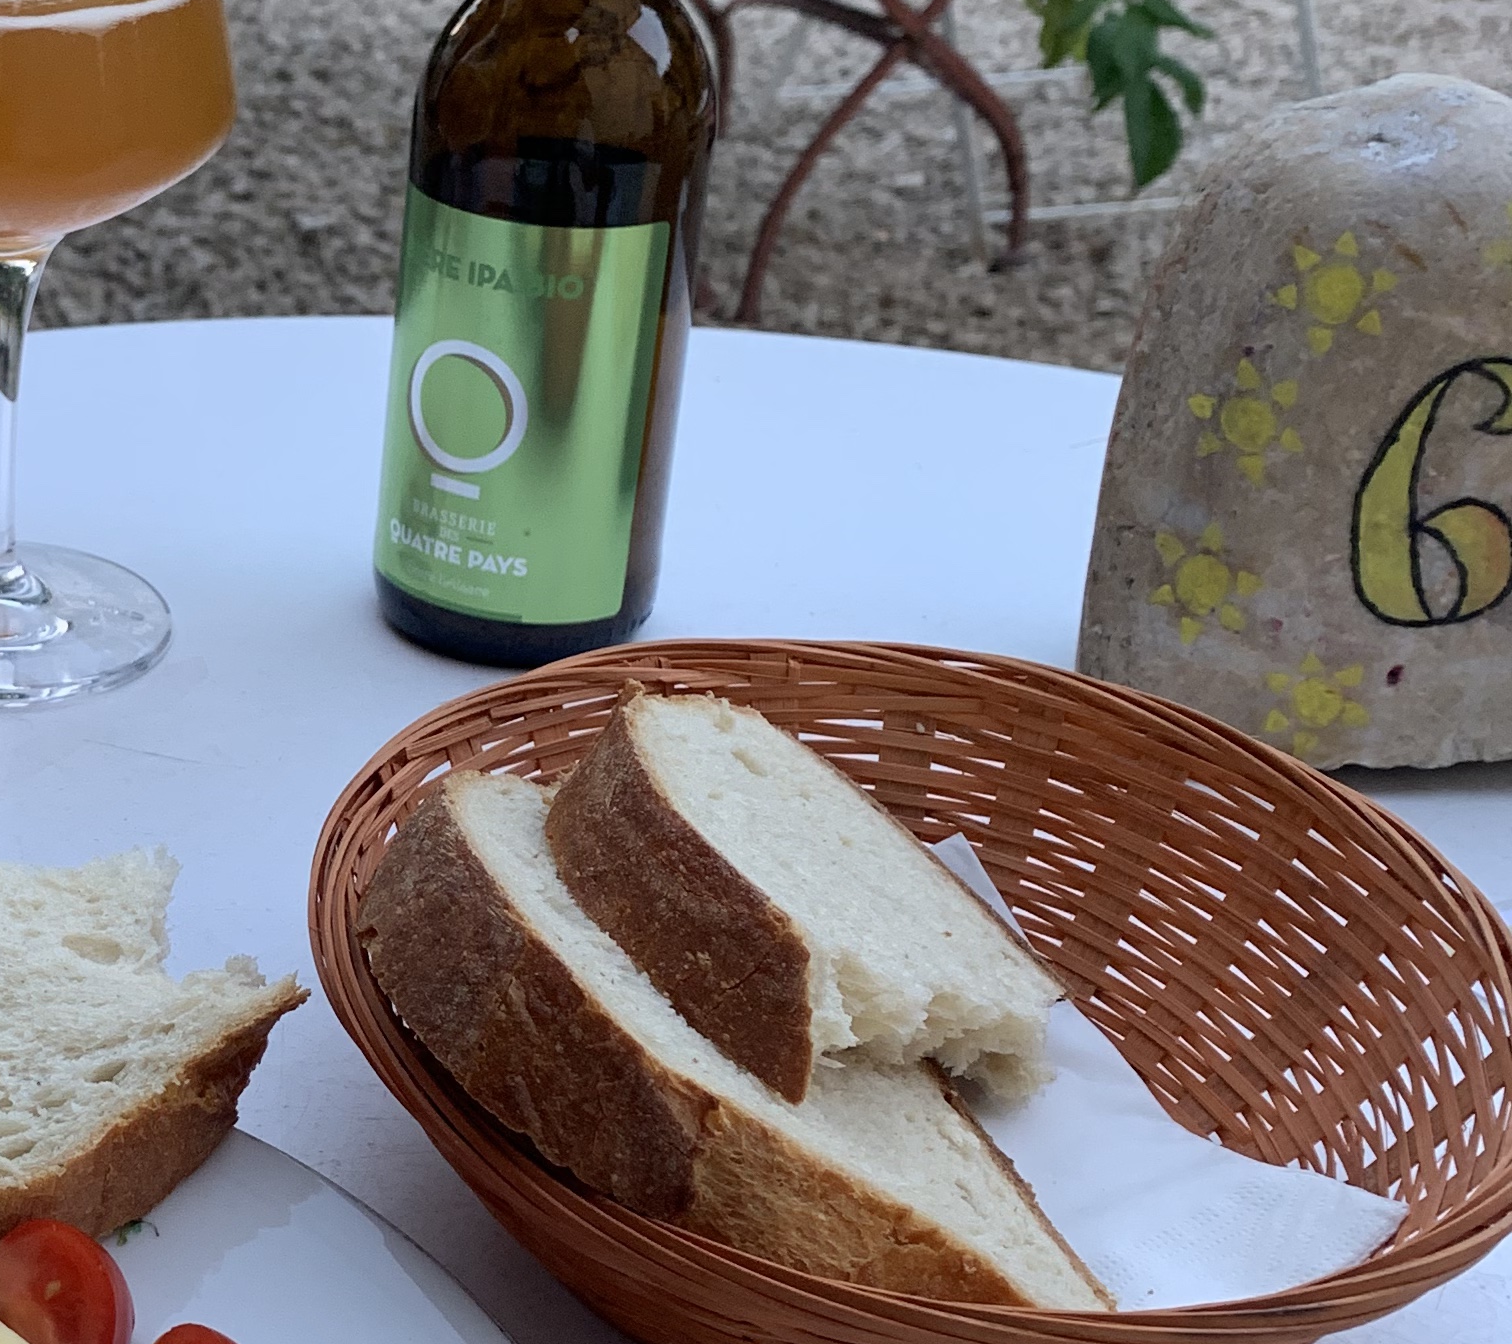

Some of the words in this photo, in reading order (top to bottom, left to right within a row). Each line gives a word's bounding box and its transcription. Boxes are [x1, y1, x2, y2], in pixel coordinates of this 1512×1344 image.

[468, 260, 513, 293] IPA
[1350, 357, 1512, 627] 6
[412, 498, 497, 536] BRASSERIE
[390, 517, 463, 566] QUATRE
[467, 549, 529, 577] PAYS
